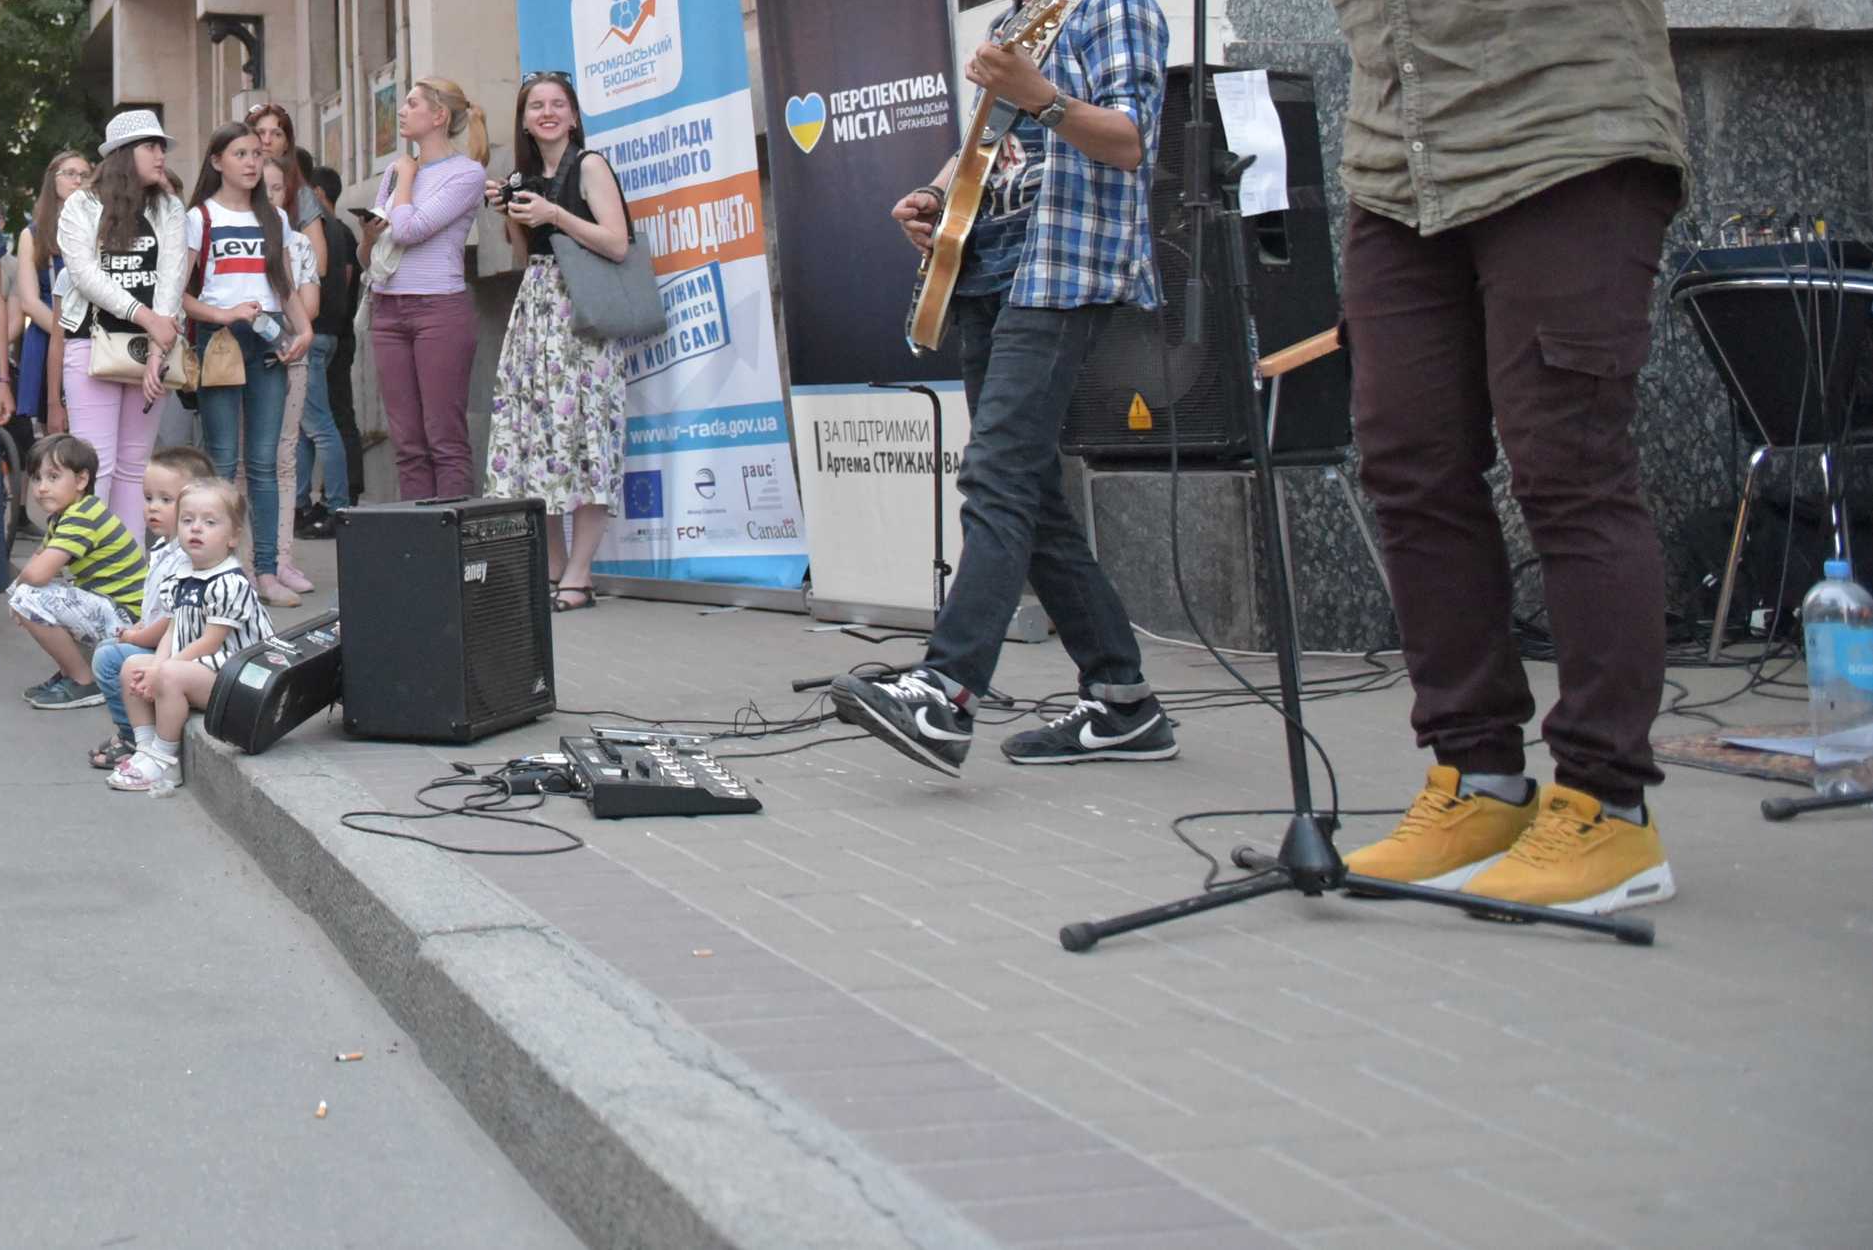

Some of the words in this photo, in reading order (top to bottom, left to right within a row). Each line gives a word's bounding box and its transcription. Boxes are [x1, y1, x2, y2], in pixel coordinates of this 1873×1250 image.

[585, 34, 672, 78] ГРОМАДСЬКИЙ
[603, 60, 657, 89] БЮДЖЕТ
[830, 72, 948, 115] ПЕРСПЕКТИВА
[895, 100, 950, 119] ГРОМАДСЬКА
[897, 113, 949, 132] ОРГАНІЗАЦІЯ
[832, 109, 891, 143] МІСТА
[615, 126, 671, 165] МІСЬКОЇ
[672, 118, 713, 149] РАДИ
[663, 274, 712, 311] ДУЖИМ
[644, 334, 677, 370] ЙОГО
[679, 320, 720, 353] САМ
[823, 420, 840, 442] ЗА
[843, 420, 931, 447] ПІДТРИМКИ
[827, 451, 871, 478] Артема
[873, 451, 960, 474] СТРИЖАКВА
[677, 526, 706, 540] FCM
[746, 520, 798, 540] Canada
[464, 562, 487, 583] aney
